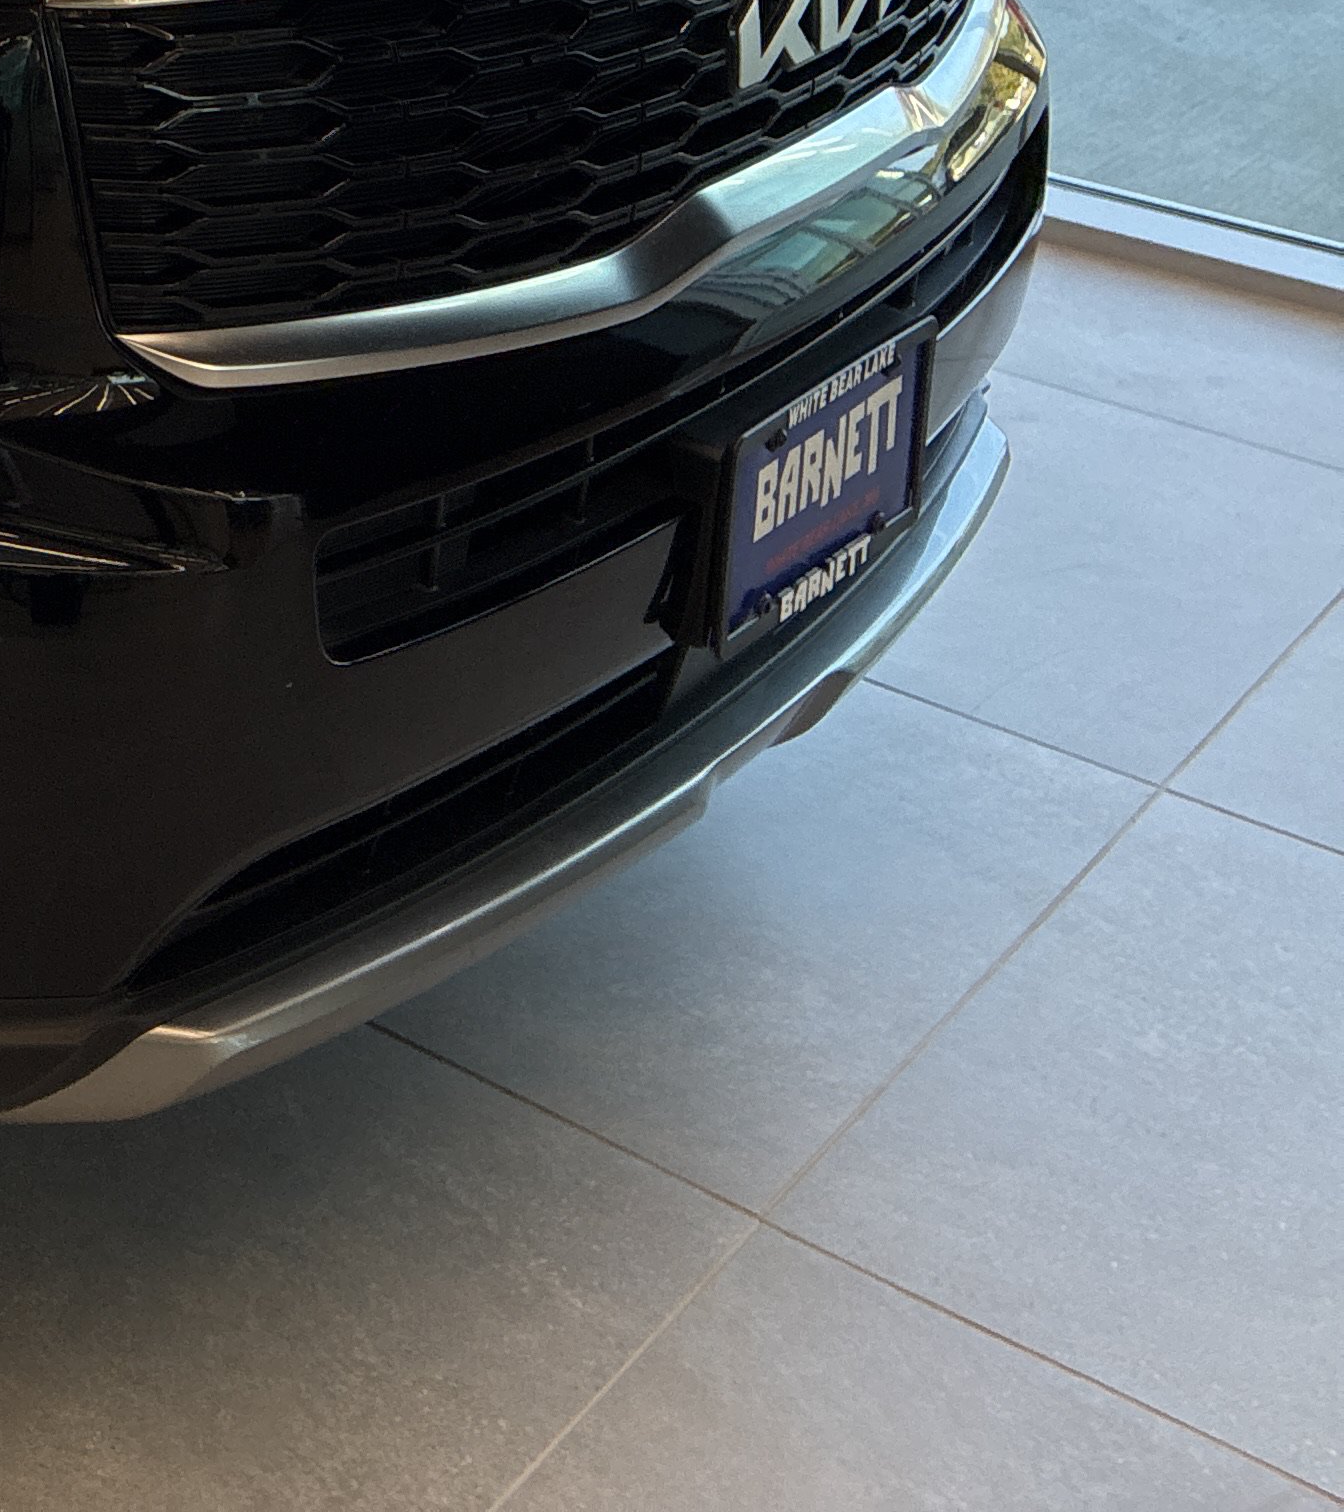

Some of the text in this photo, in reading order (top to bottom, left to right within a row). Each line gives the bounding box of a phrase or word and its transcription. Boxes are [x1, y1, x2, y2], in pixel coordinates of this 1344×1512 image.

[788, 341, 896, 429] WHITE BEAR LAKE
[752, 375, 903, 544] BARNETT
[778, 533, 872, 623] BARNETT
